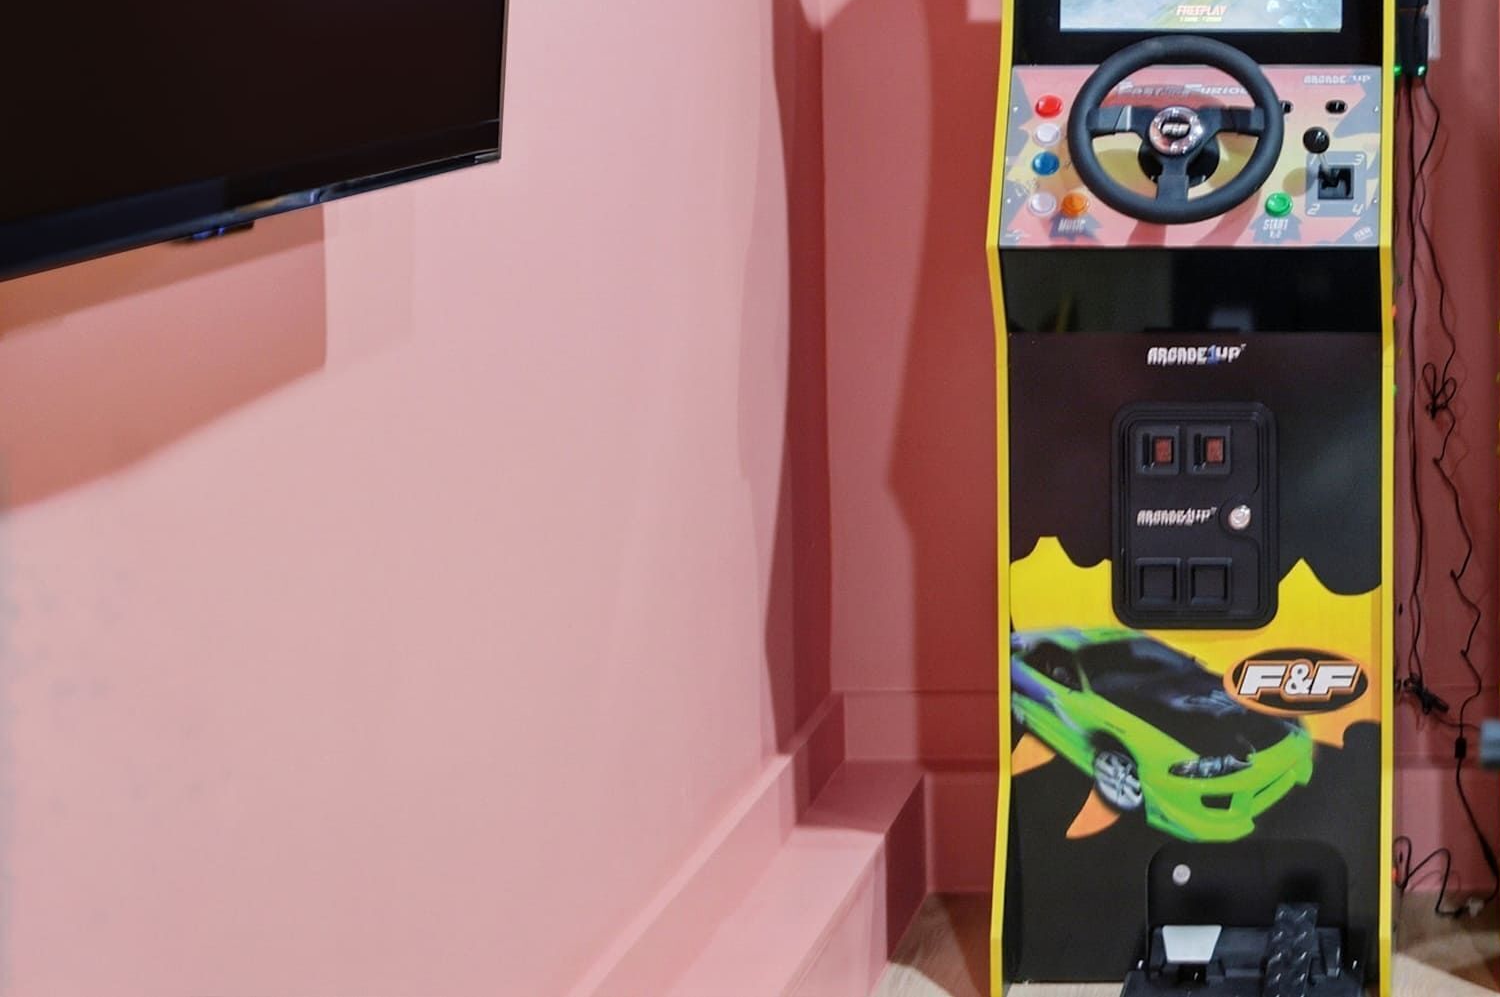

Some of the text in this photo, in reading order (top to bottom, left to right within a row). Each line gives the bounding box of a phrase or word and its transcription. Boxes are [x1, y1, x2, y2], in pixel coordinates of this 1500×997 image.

[1306, 203, 1320, 216] 2
[1352, 203, 1365, 216] 4
[1147, 344, 1243, 367] ARCADE1UP
[1238, 661, 1359, 696] F&F
